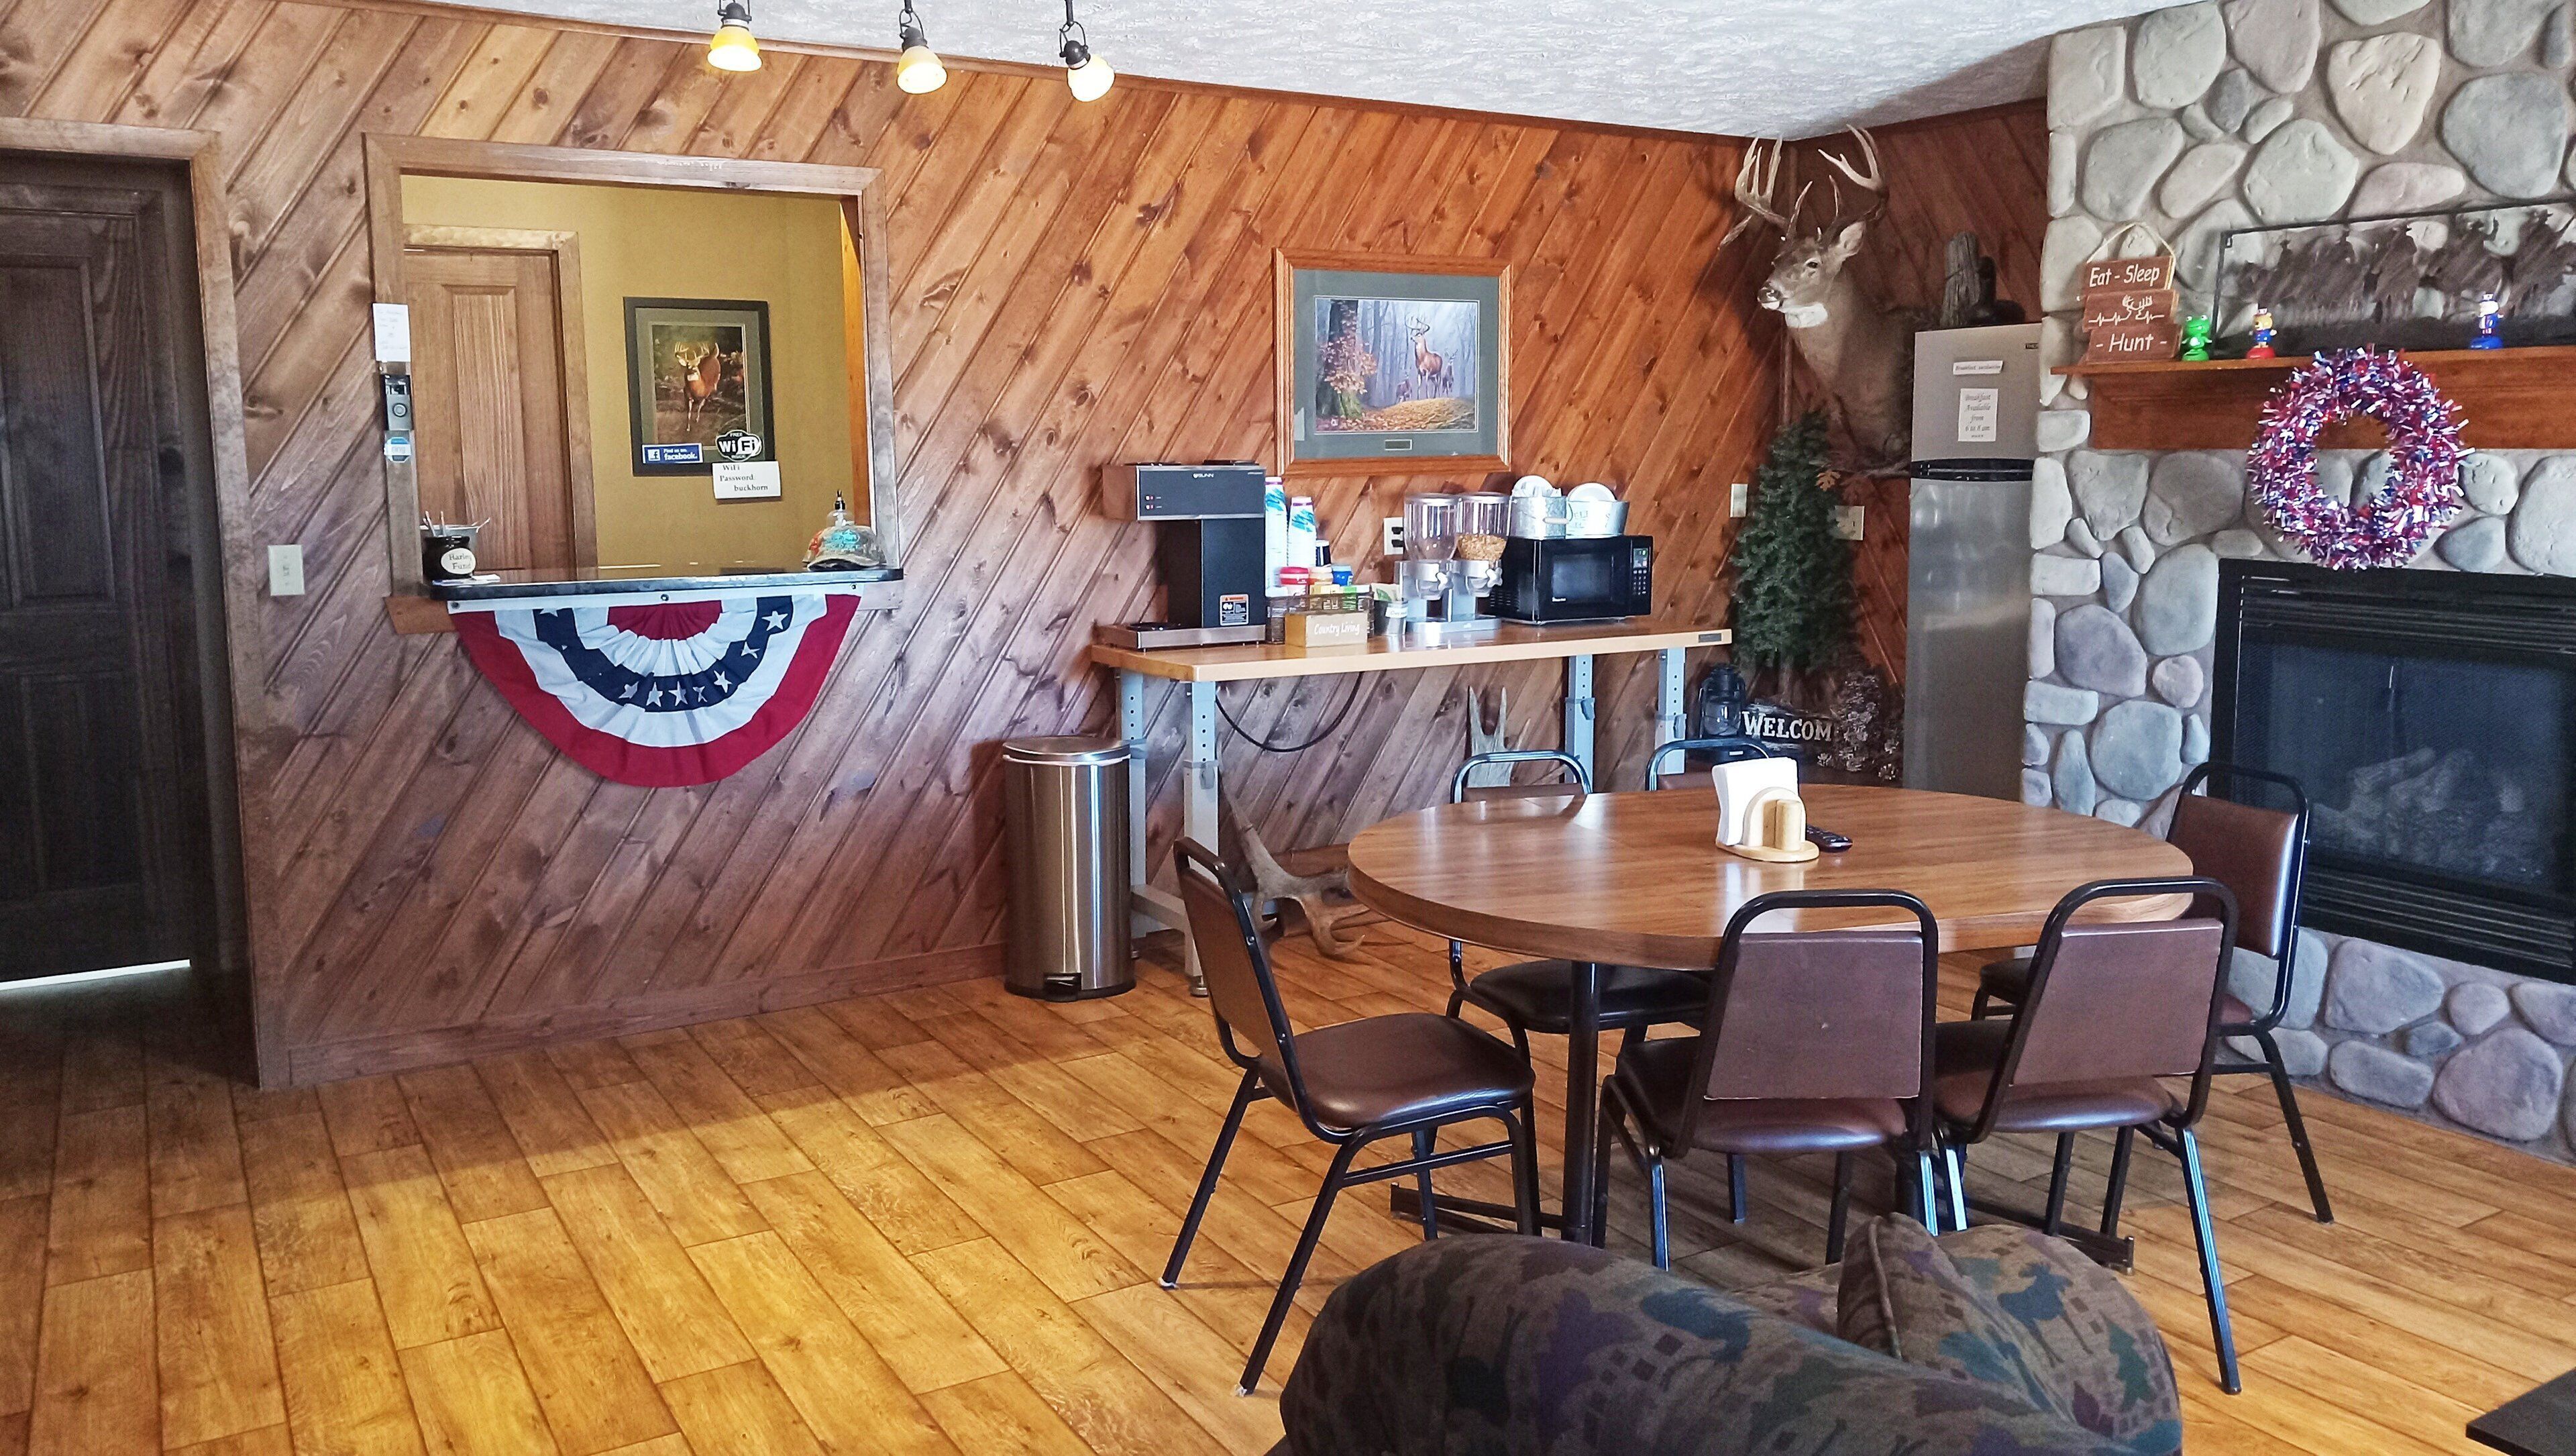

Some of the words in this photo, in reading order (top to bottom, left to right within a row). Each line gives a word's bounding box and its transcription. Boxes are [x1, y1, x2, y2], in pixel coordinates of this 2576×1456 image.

[2089, 267, 2112, 287] Eat
[2124, 264, 2159, 287] Sleep
[2108, 333, 2154, 352] Hunt
[1314, 623, 1340, 636] Country
[1341, 621, 1360, 635] Living
[1741, 711, 1833, 741] WELCOM
